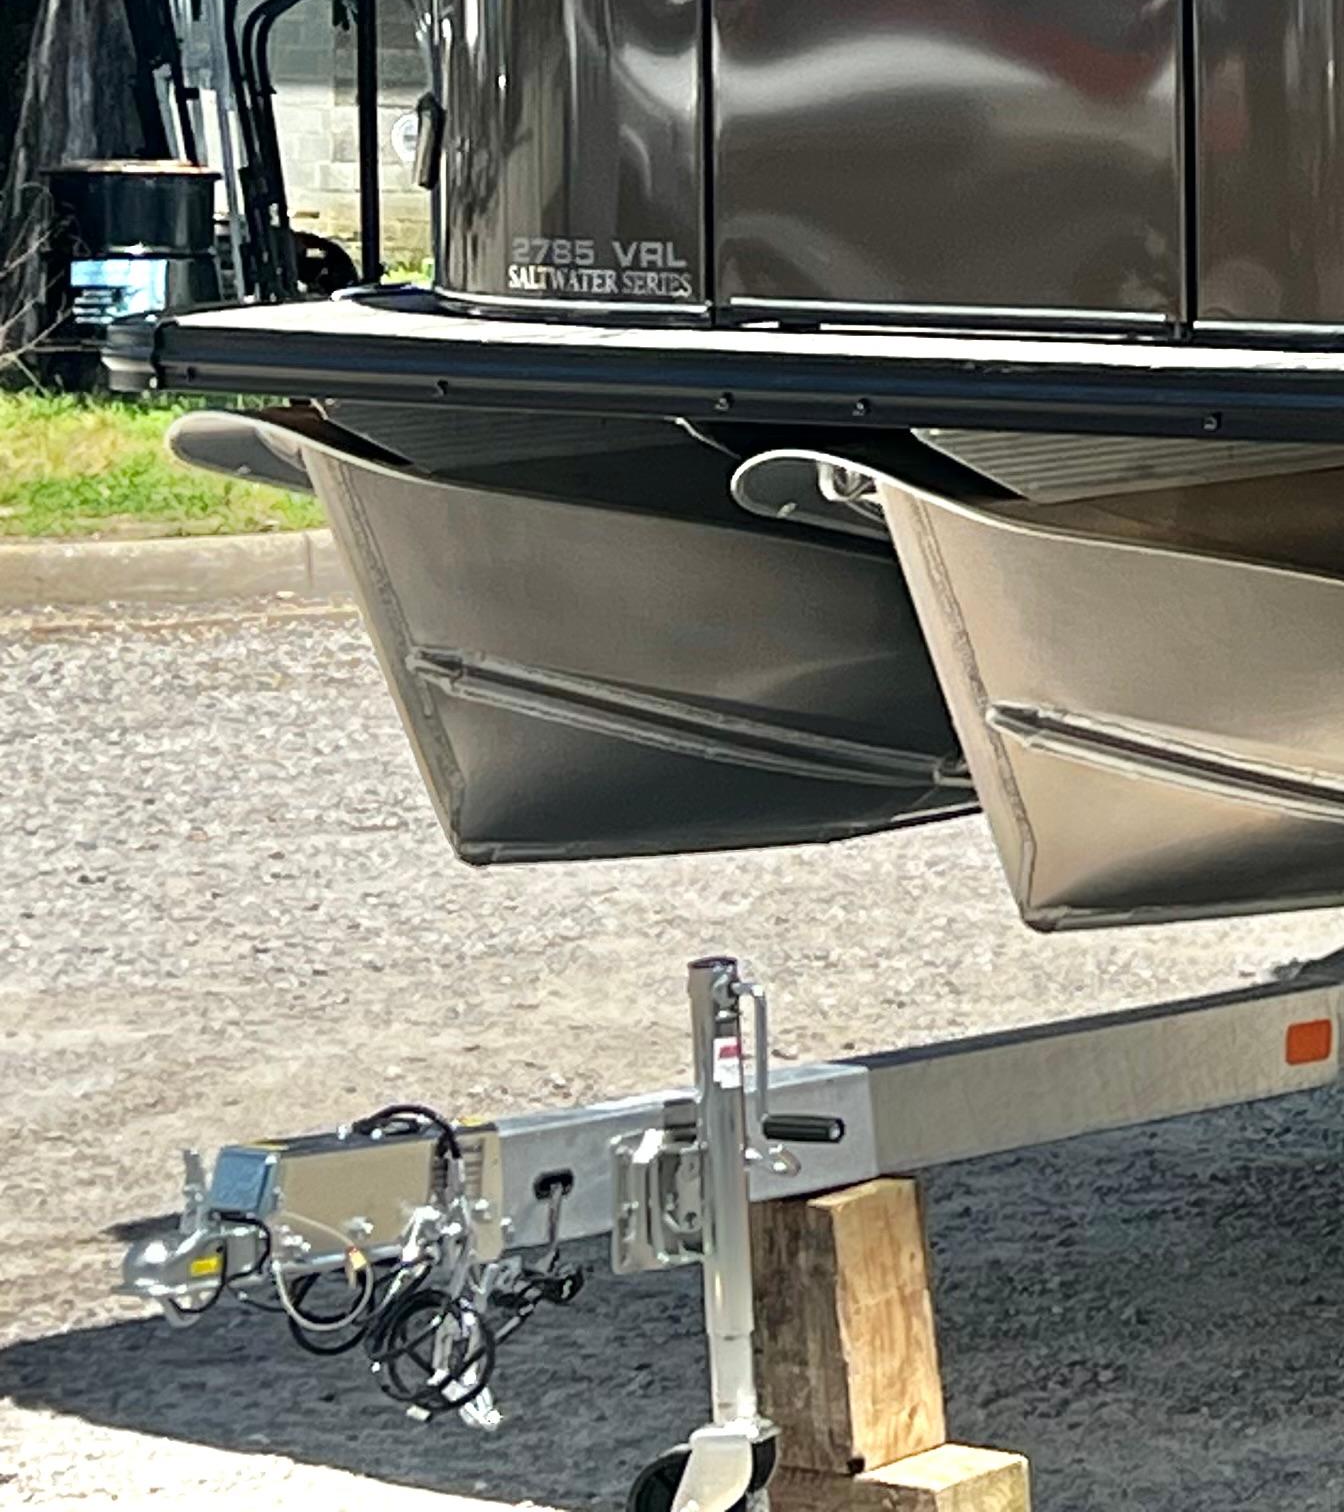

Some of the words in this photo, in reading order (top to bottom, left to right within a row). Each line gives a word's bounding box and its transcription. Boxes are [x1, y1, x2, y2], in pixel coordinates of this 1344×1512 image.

[511, 238, 594, 265] 2785
[508, 264, 618, 294] SALTWATER
[622, 270, 692, 298] SERIES
